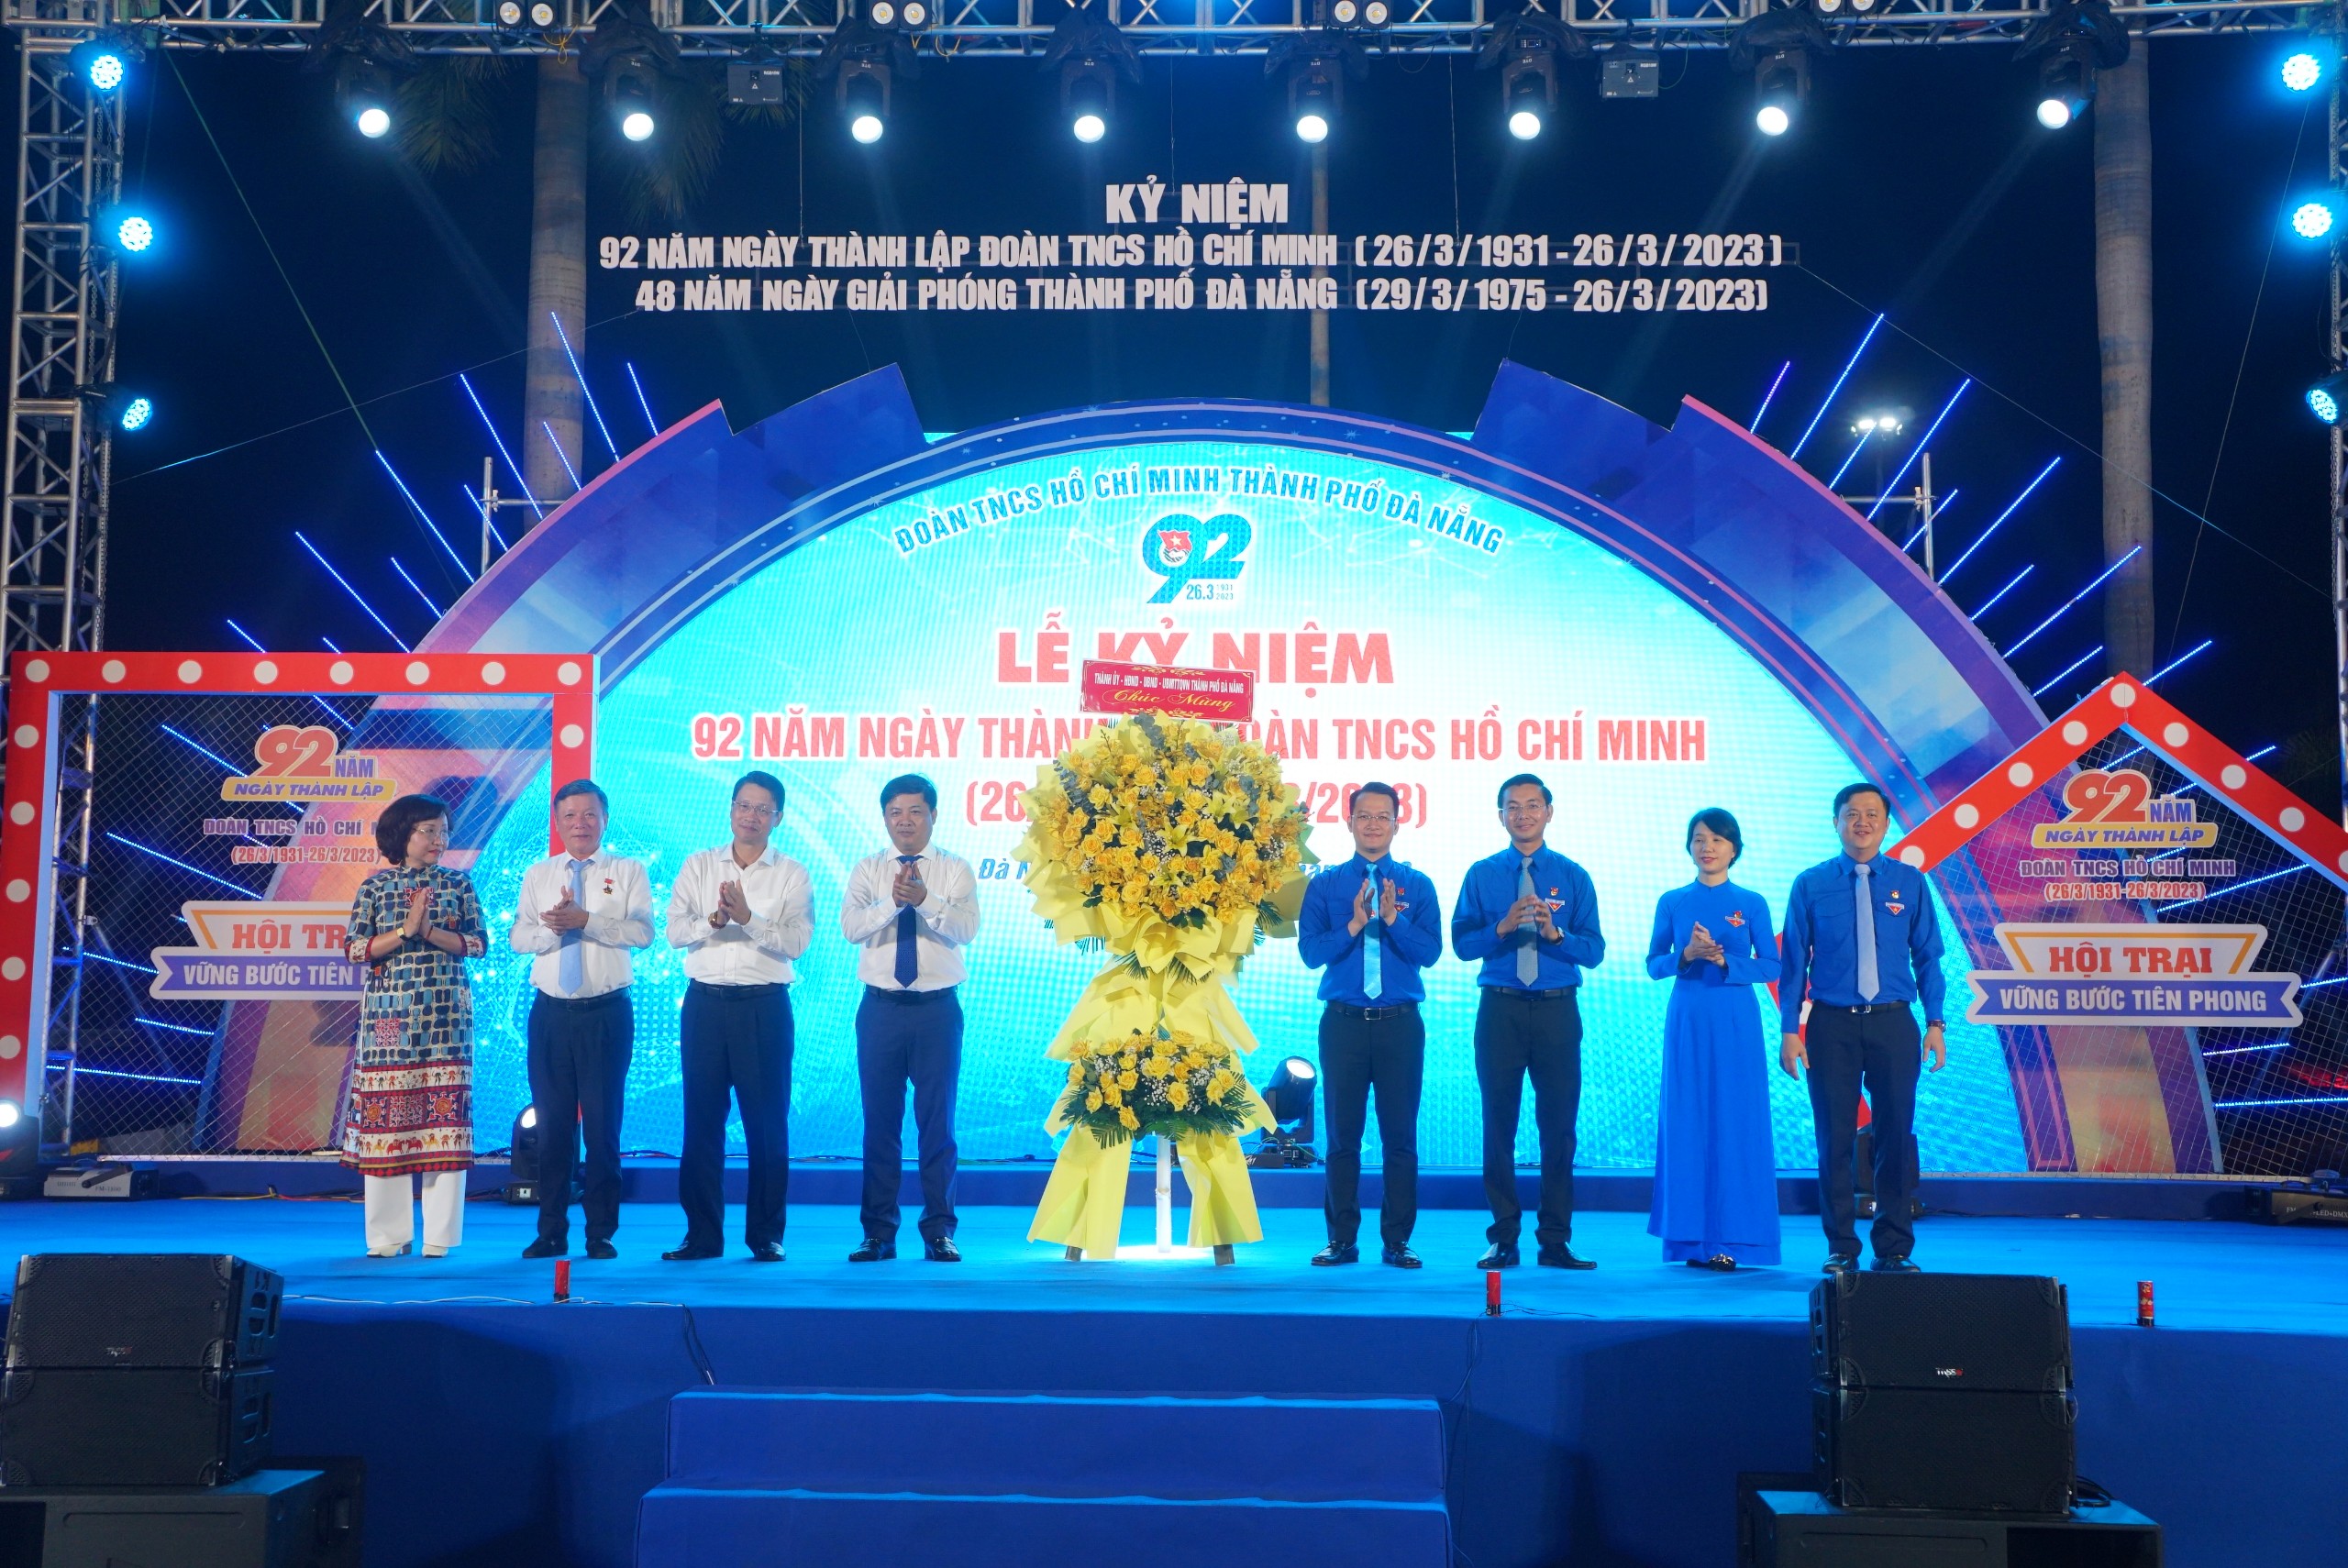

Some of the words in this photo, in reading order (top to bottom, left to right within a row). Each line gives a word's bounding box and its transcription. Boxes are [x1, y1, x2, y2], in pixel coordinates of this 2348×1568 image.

[1106, 175, 1165, 224] KỶ
[1181, 177, 1289, 230] NIỆM
[599, 237, 638, 269] 92
[647, 232, 714, 269] NĂM
[723, 230, 798, 268] NGÀY
[807, 231, 906, 268] THÀNH
[915, 230, 970, 273] LẬP
[979, 230, 1058, 267] ĐOÀN
[1068, 234, 1146, 267] TNCS
[1154, 225, 1194, 267] HỒ
[1202, 229, 1254, 267] CHÍ
[1262, 236, 1337, 267] MINH
[636, 280, 675, 312] 48
[683, 275, 751, 311] NĂM
[762, 275, 839, 311] NGÀY
[847, 271, 907, 311] GIẢI
[919, 273, 1017, 311] PHÓNG
[1025, 273, 1124, 310] THÀNH
[1135, 267, 1193, 310] PHỐ
[1206, 273, 1247, 310] ĐÀ
[1256, 268, 1337, 310] NẴNG
[894, 511, 969, 553] ĐOÀN
[972, 485, 1043, 524] TNCS
[1050, 469, 1085, 505] HỒ
[1095, 466, 1138, 499] CHÍ
[1149, 469, 1218, 492] MINH
[1231, 466, 1318, 501] THÀNH
[1326, 480, 1382, 513] PHỐ
[1386, 493, 1422, 525] ĐÀ
[1427, 504, 1503, 553] NẴNG
[1142, 513, 1252, 603] 92
[1186, 584, 1213, 600] 26.3
[998, 612, 1069, 683] LỄ
[1213, 622, 1394, 698] NIỆM
[1102, 690, 1166, 706] Chúc
[694, 717, 741, 758] 92
[754, 706, 844, 758] NĂM
[859, 708, 965, 758] NGÀY
[1334, 718, 1435, 761] TNCS
[1451, 704, 1502, 761] HỒ
[1518, 711, 1584, 761] CHÍ
[1599, 720, 1705, 761] MINH
[256, 728, 335, 777] 92
[335, 756, 374, 778] NĂM
[234, 781, 285, 796] NGÀY
[289, 781, 348, 796] THÀNH
[350, 782, 384, 800] LẬP
[2066, 773, 2148, 823] 92
[2150, 799, 2192, 823] NĂM
[204, 817, 248, 834] ĐOÀN
[255, 820, 297, 835] TNCS
[304, 817, 328, 834] HỒ
[334, 819, 361, 835] CHÍ
[2044, 827, 2100, 843] NGÀY
[2102, 827, 2165, 843] THÀNH
[2169, 826, 2205, 845] LẬP
[979, 858, 1010, 879] Đà
[2021, 859, 2065, 877] ĐOÀN
[2073, 860, 2119, 877] TNCS
[2123, 855, 2148, 876] HỒ
[2152, 857, 2185, 876] CHÍ
[2189, 860, 2236, 876] MINH
[2045, 883, 2206, 901] (26/3/1931-26/3/2023)
[232, 919, 292, 955] HỘI
[2049, 941, 2112, 977] HỘI
[2123, 947, 2212, 977] TRẠI
[183, 961, 238, 986] VỮNG
[245, 962, 301, 986] BƯỚC
[307, 961, 354, 986] TIÊN
[1999, 986, 2059, 1010] VỮNG
[2066, 986, 2125, 1010] BƯỚC
[2132, 985, 2182, 1010] TIÊN
[2190, 989, 2267, 1011] PHONG
